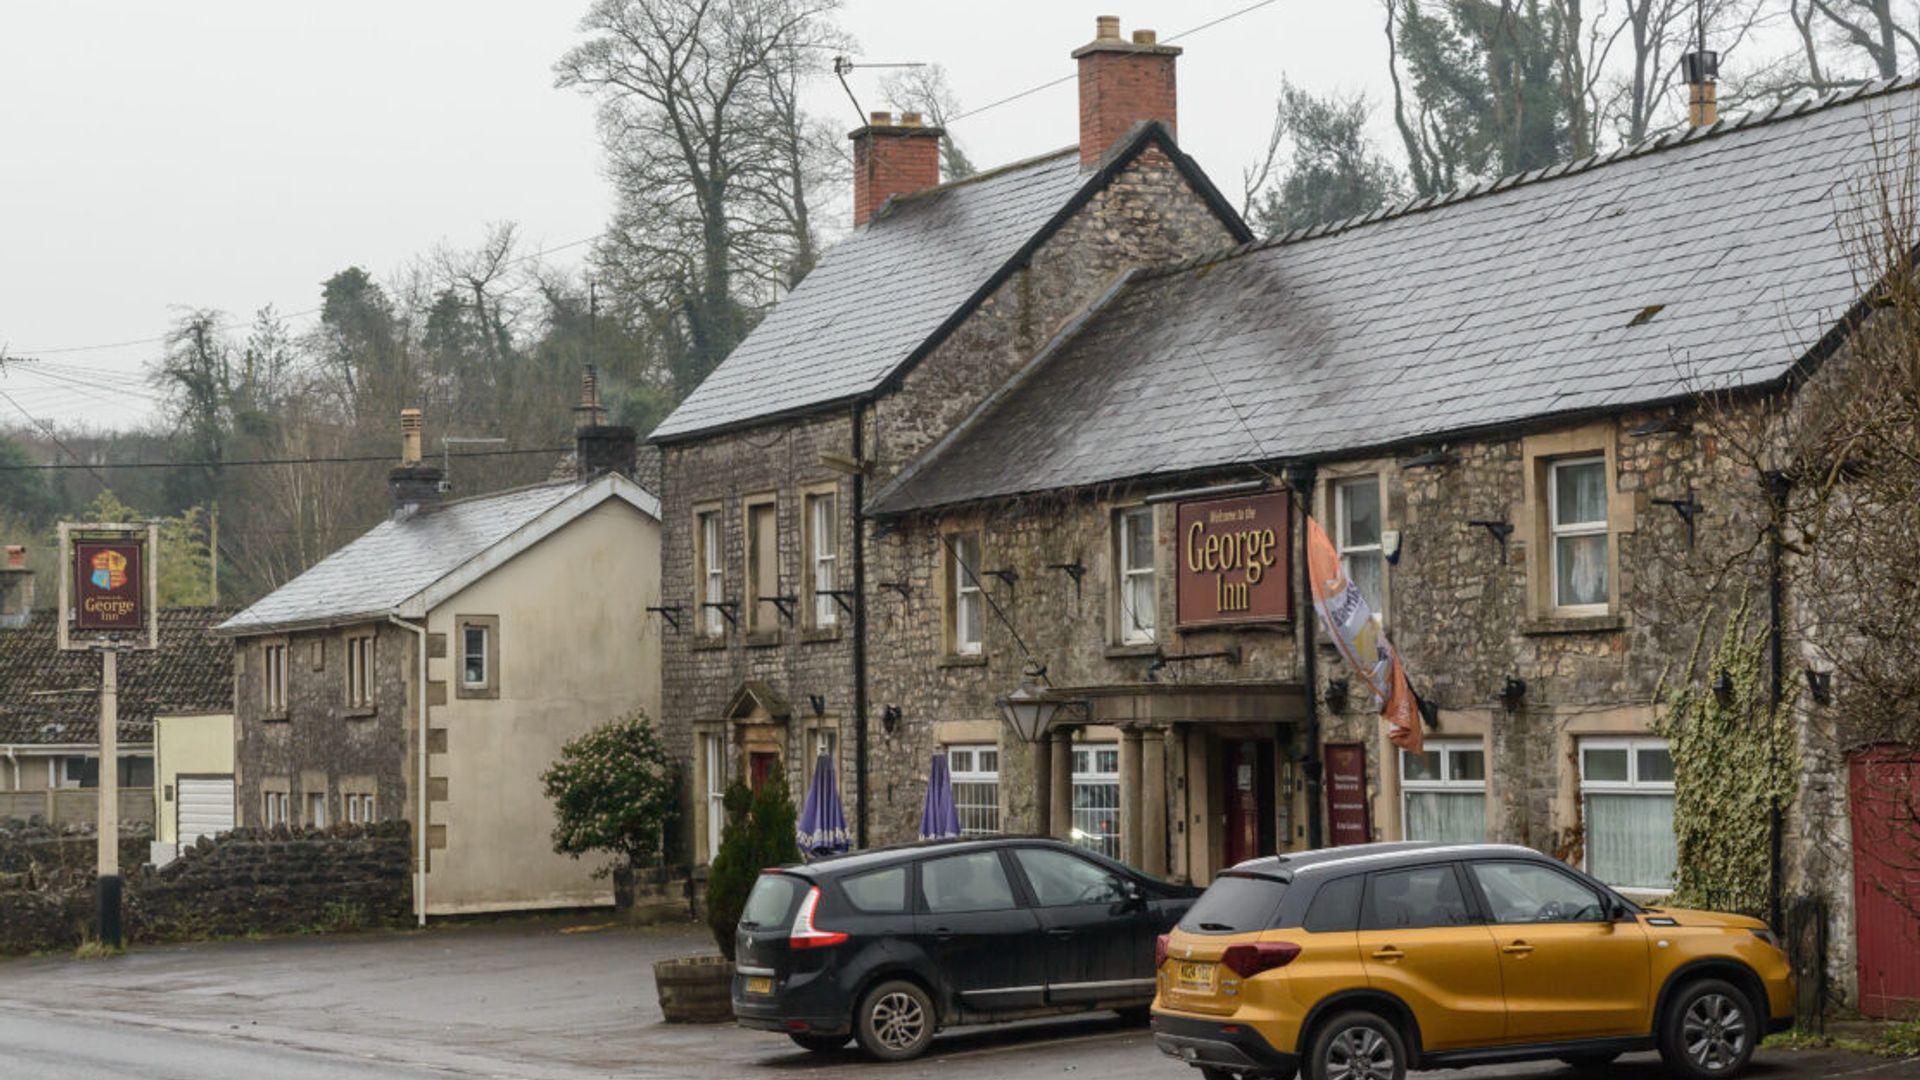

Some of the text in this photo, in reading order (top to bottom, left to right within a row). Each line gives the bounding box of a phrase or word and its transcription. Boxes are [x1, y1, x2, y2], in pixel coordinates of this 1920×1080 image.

[1187, 521, 1276, 583] George
[84, 597, 135, 615] George
[1216, 573, 1248, 611] Inn
[100, 611, 119, 621] Inn
